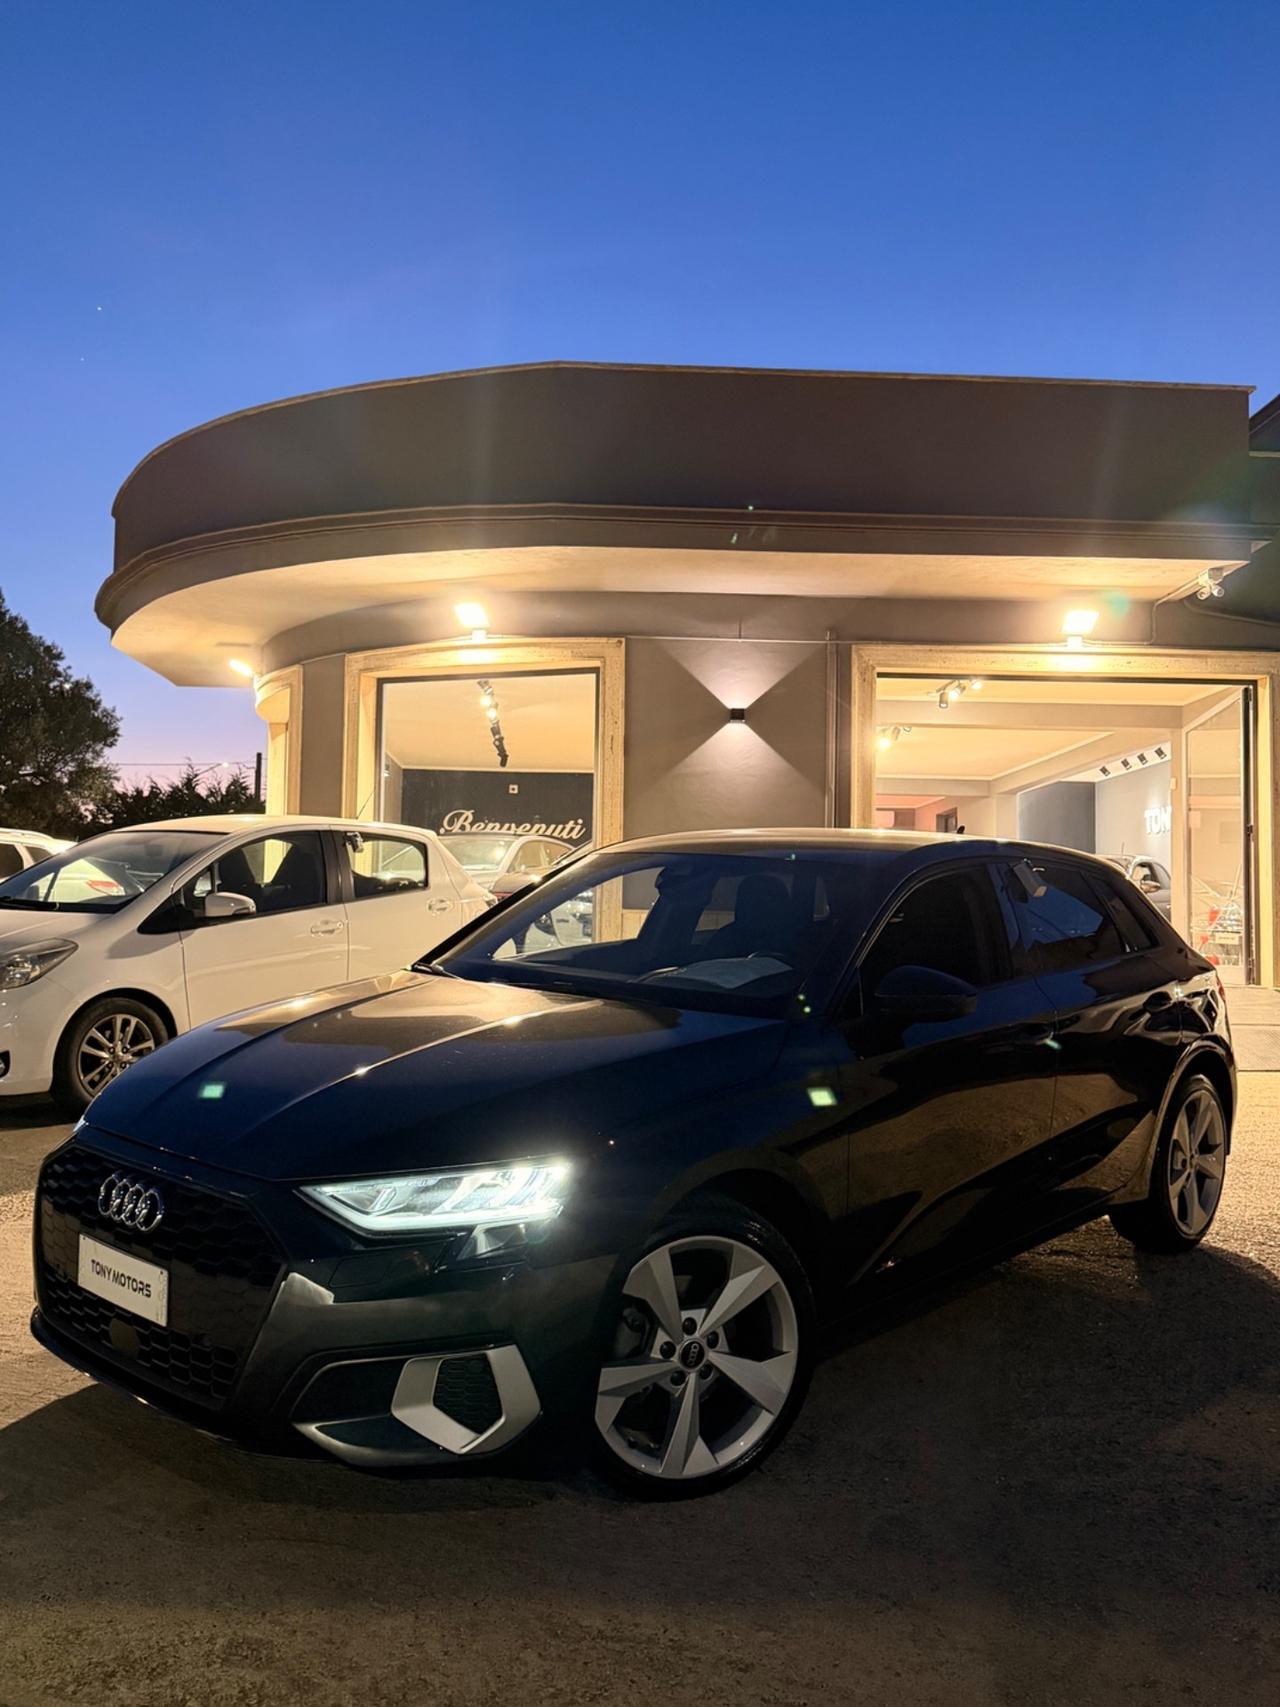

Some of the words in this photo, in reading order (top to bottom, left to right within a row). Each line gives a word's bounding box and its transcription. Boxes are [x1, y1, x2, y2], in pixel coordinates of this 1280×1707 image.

[440, 809, 586, 839] Benvenuti
[91, 1259, 112, 1281] TONY
[112, 1270, 151, 1298] MOTORS
